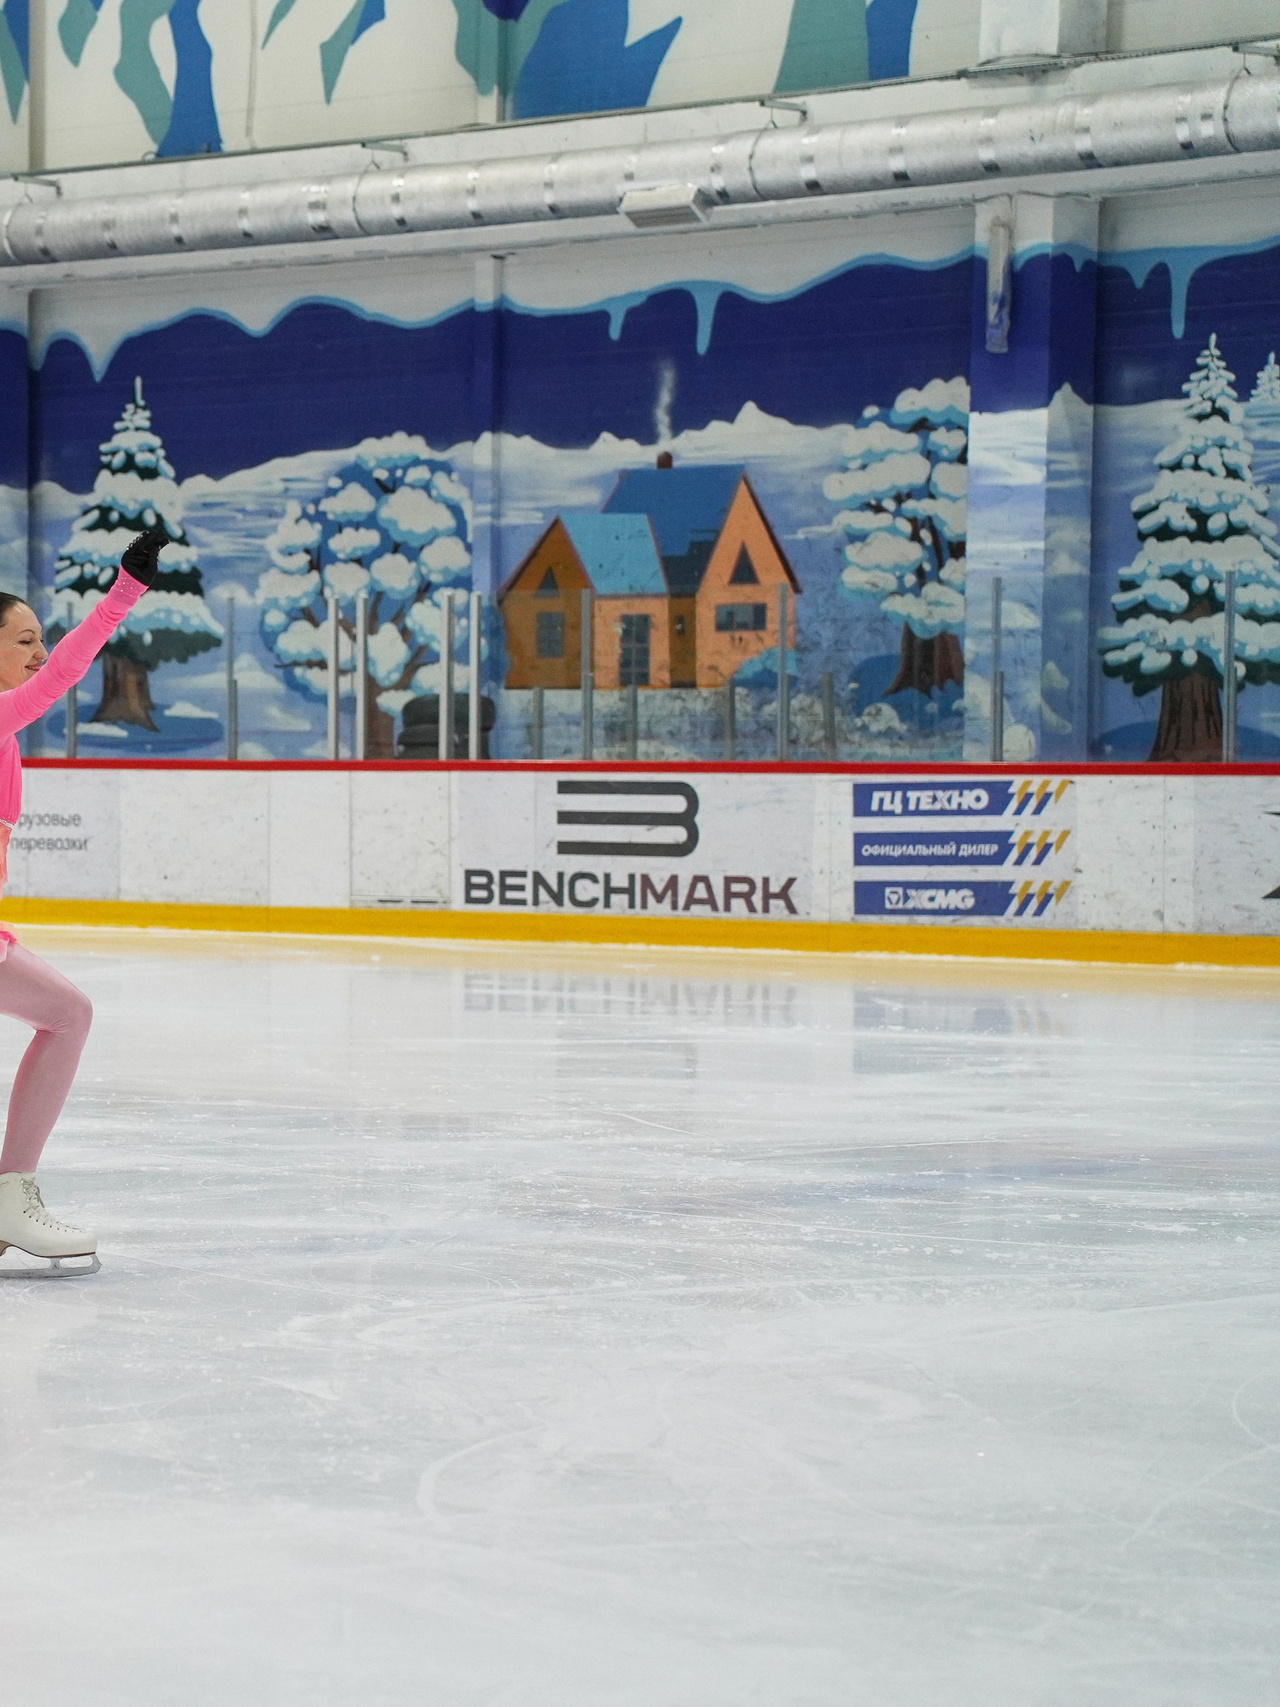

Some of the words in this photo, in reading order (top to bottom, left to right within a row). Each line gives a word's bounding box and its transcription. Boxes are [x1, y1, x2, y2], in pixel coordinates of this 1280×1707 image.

[871, 790, 903, 814] ГЦ
[906, 788, 989, 811] ТЕХНО
[18, 813, 81, 831] рузовые
[861, 841, 957, 857] ОФИЦИАЛЬНЫЙ
[958, 843, 999, 857] ДИЛЕР
[464, 869, 799, 914] BENCHMARK
[905, 888, 975, 910] XCMG
